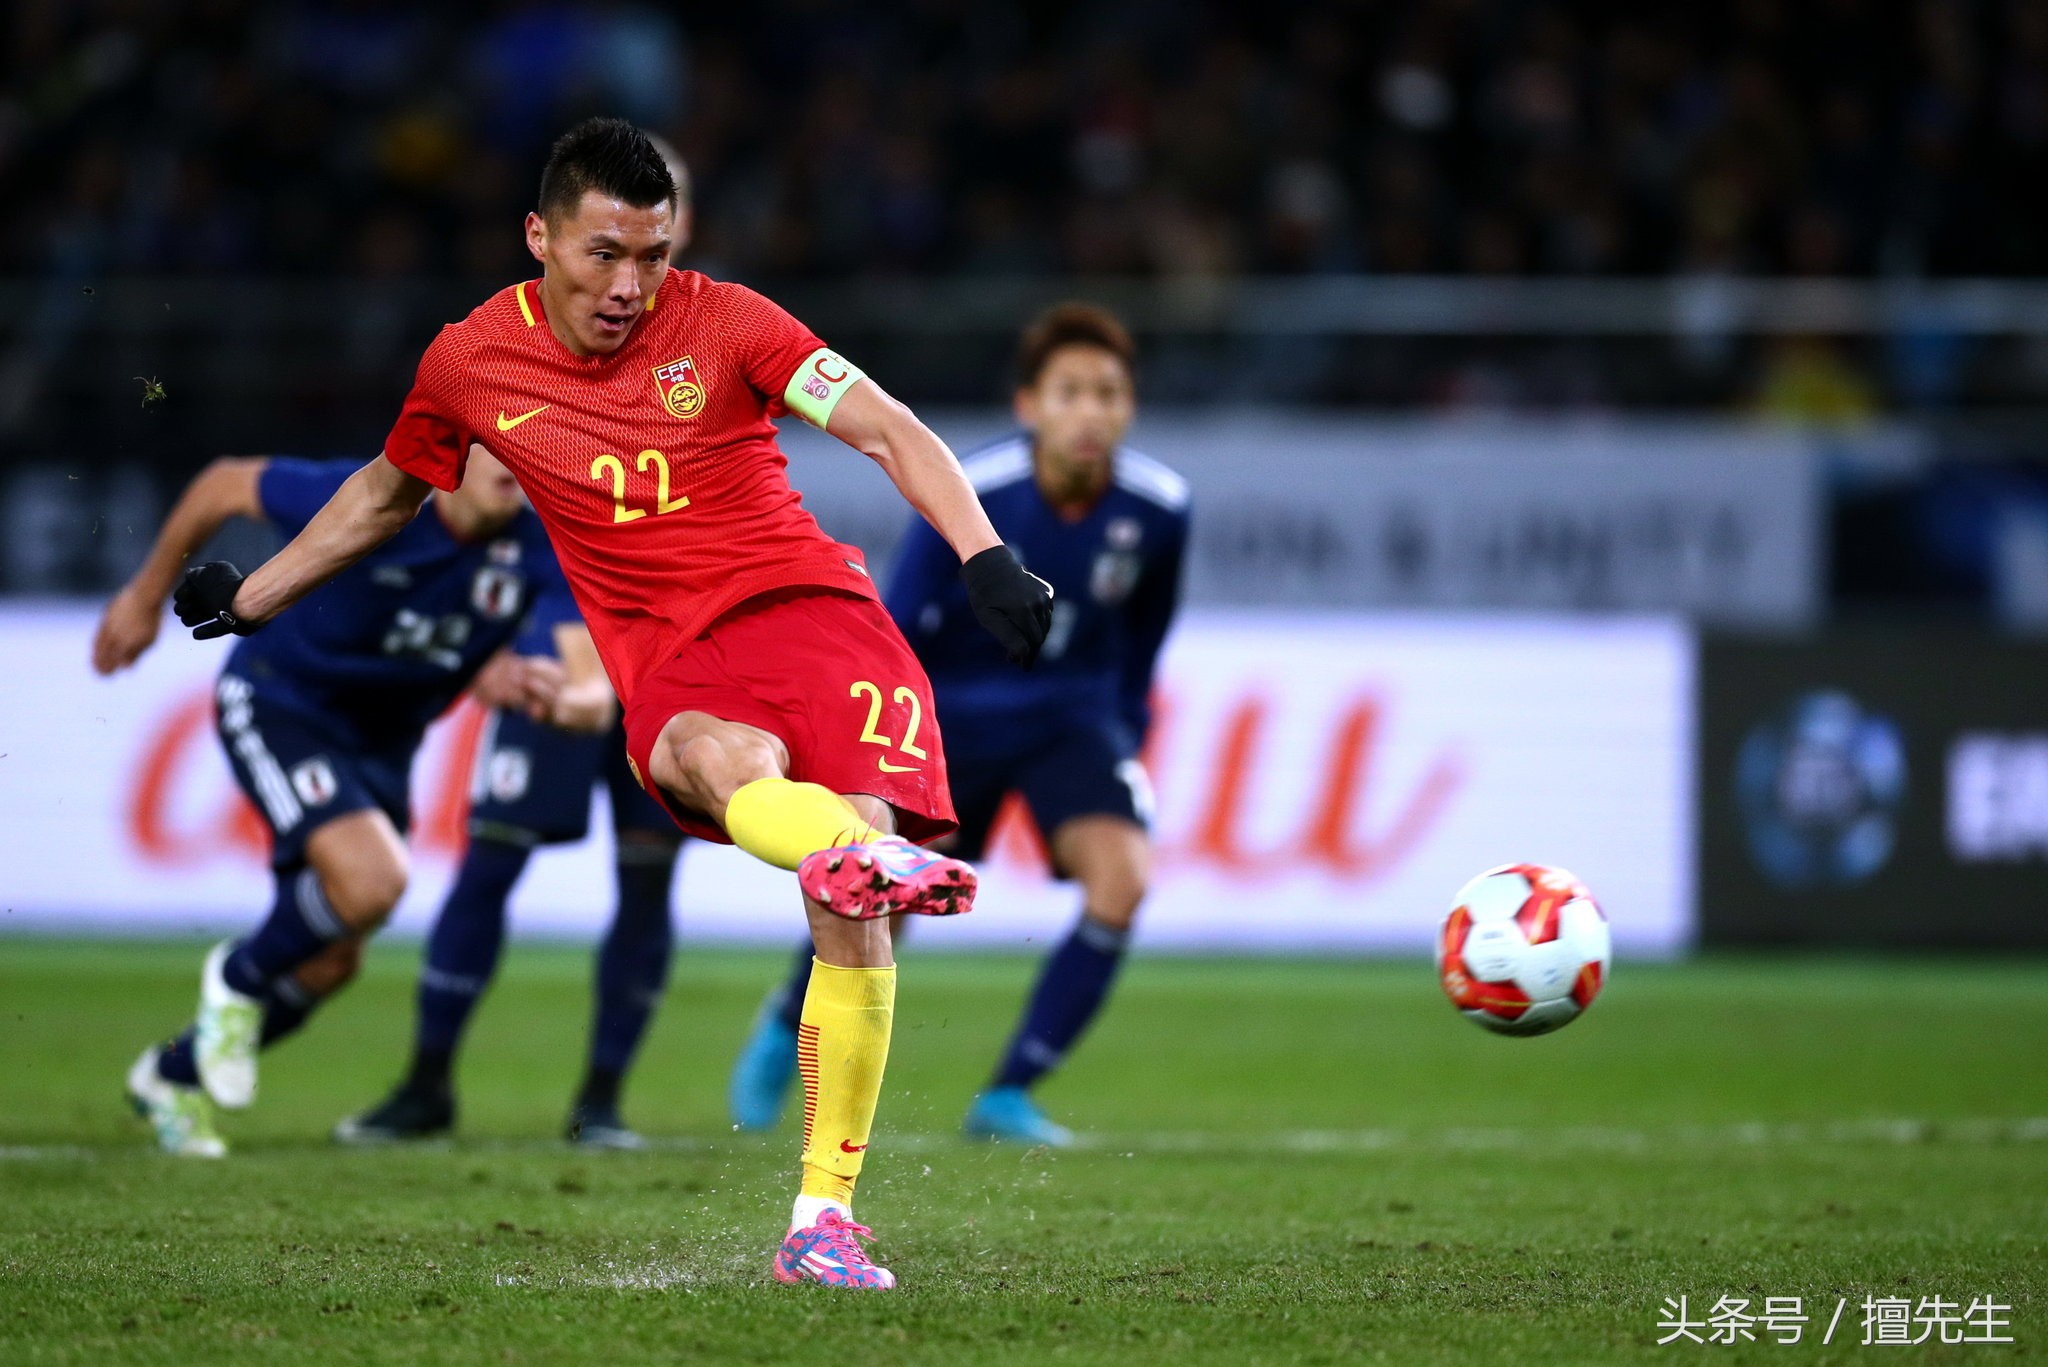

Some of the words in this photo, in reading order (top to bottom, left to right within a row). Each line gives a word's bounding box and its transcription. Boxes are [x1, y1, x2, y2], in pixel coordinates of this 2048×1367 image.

[657, 360, 691, 380] CFA
[815, 358, 847, 383] C
[591, 449, 690, 523] 22
[849, 680, 927, 761] 22
